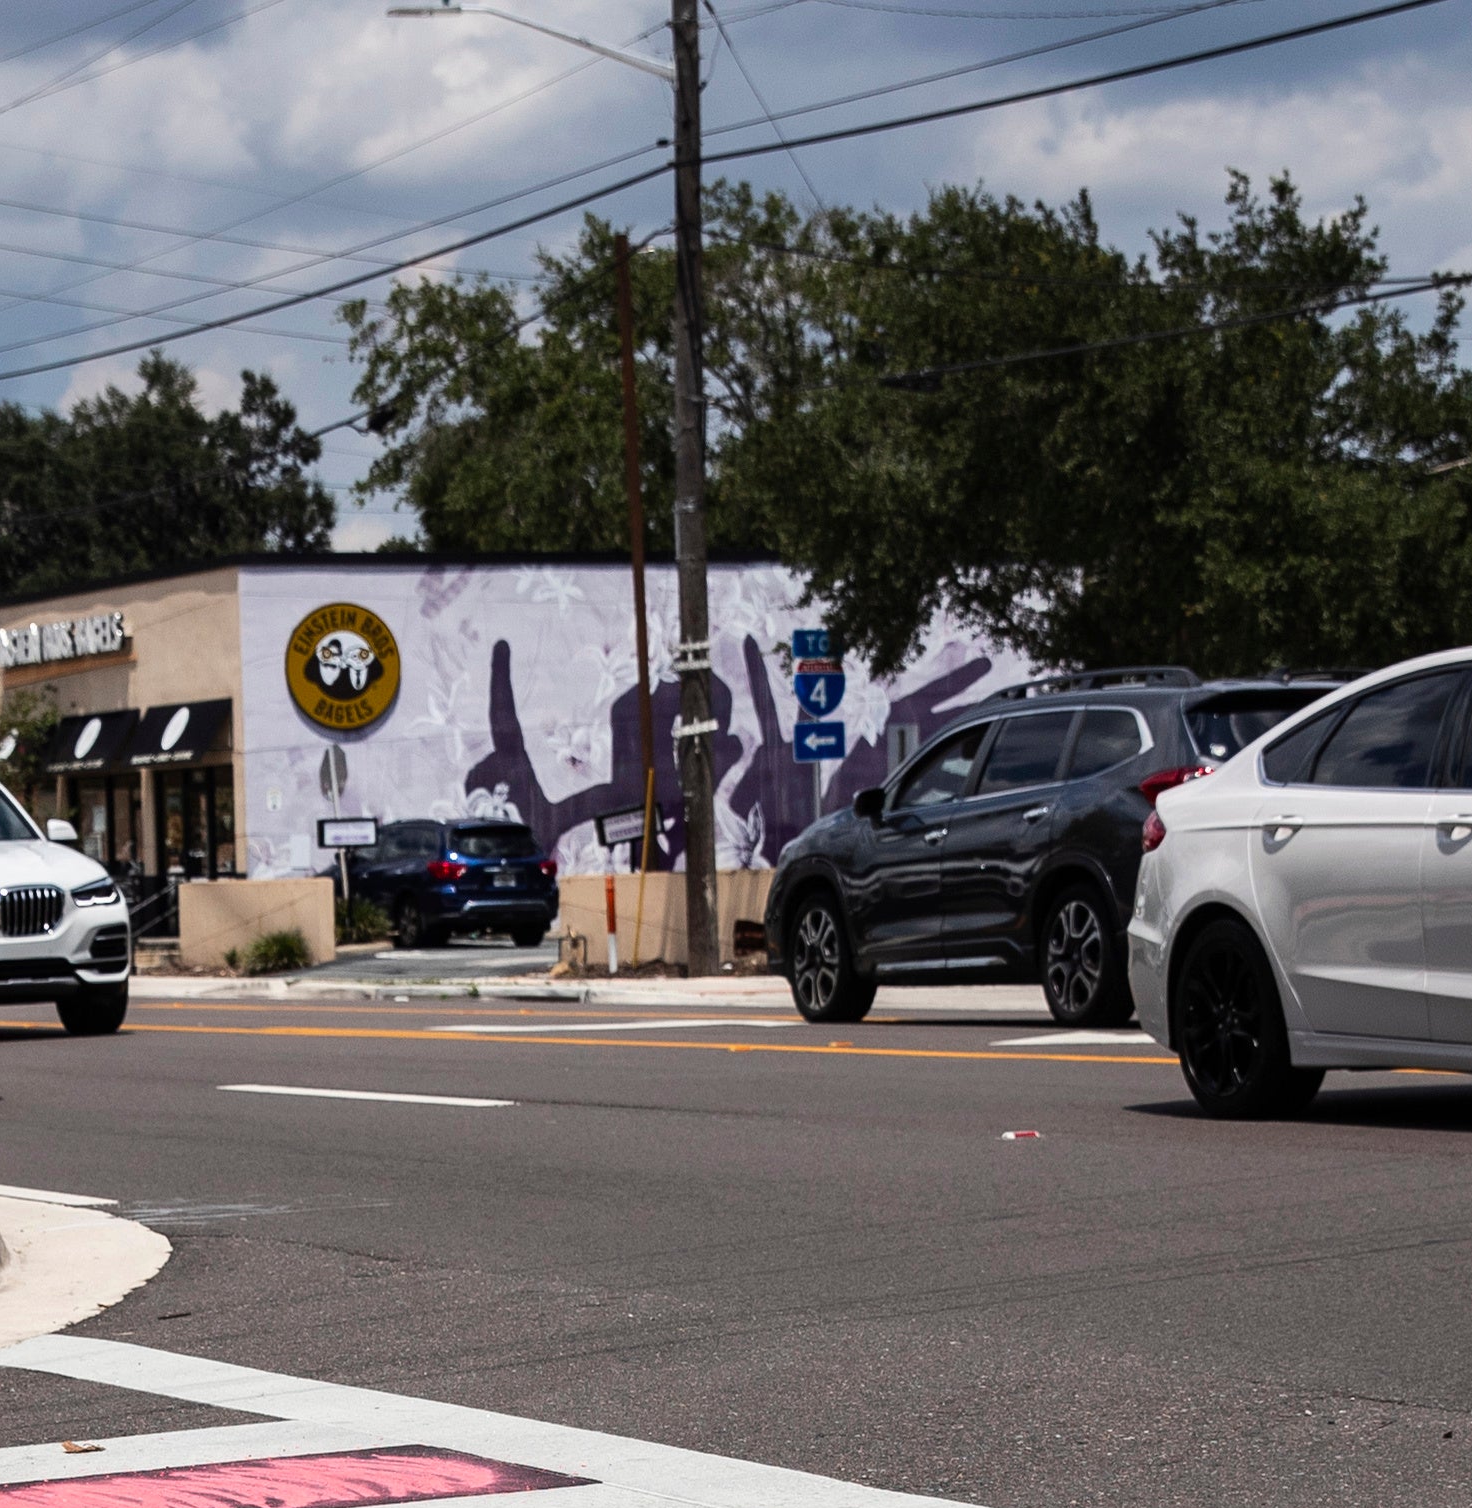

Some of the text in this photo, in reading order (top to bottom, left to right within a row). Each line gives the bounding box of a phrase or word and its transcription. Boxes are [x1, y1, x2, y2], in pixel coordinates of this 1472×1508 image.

[293, 608, 357, 657] EINSTEIN
[809, 678, 827, 709] 4
[313, 698, 375, 724] BAGELS
